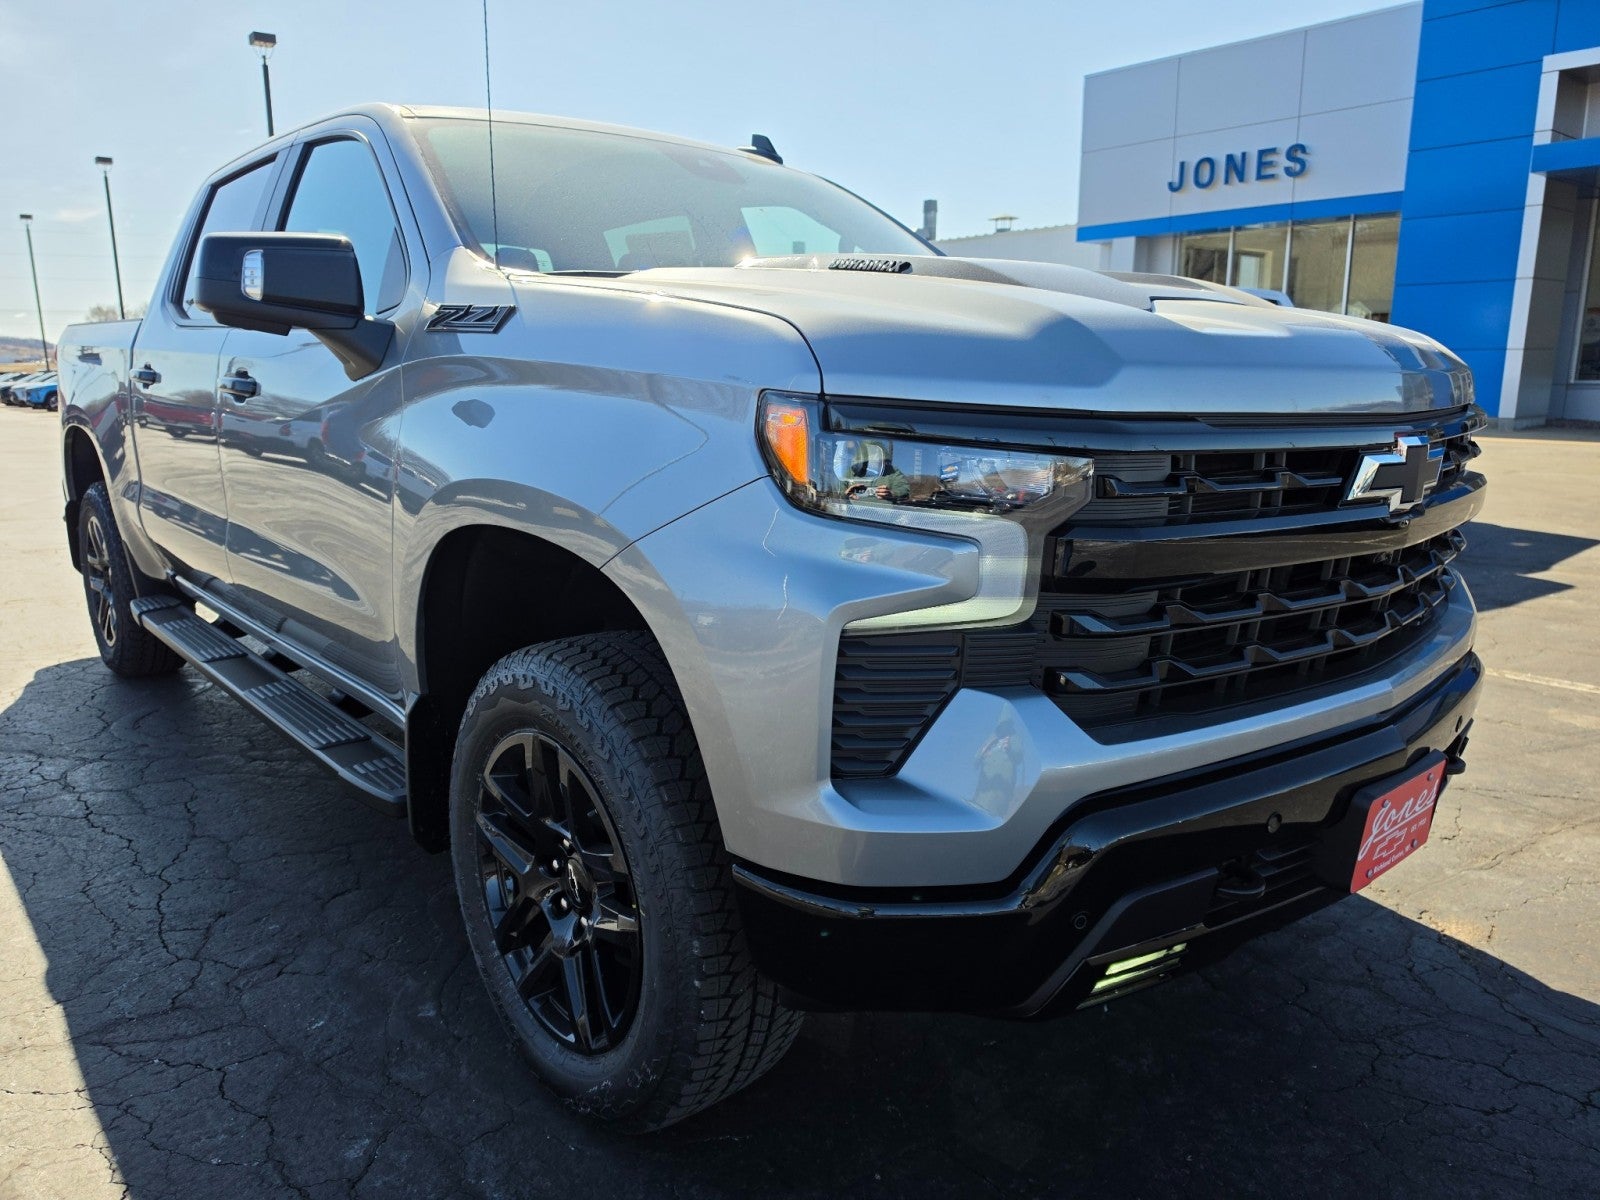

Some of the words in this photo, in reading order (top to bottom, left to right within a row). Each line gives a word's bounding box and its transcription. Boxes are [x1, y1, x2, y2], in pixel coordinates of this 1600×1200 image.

[1167, 143, 1309, 193] JONES
[425, 304, 516, 334] Z71
[1357, 779, 1439, 861] Jones
